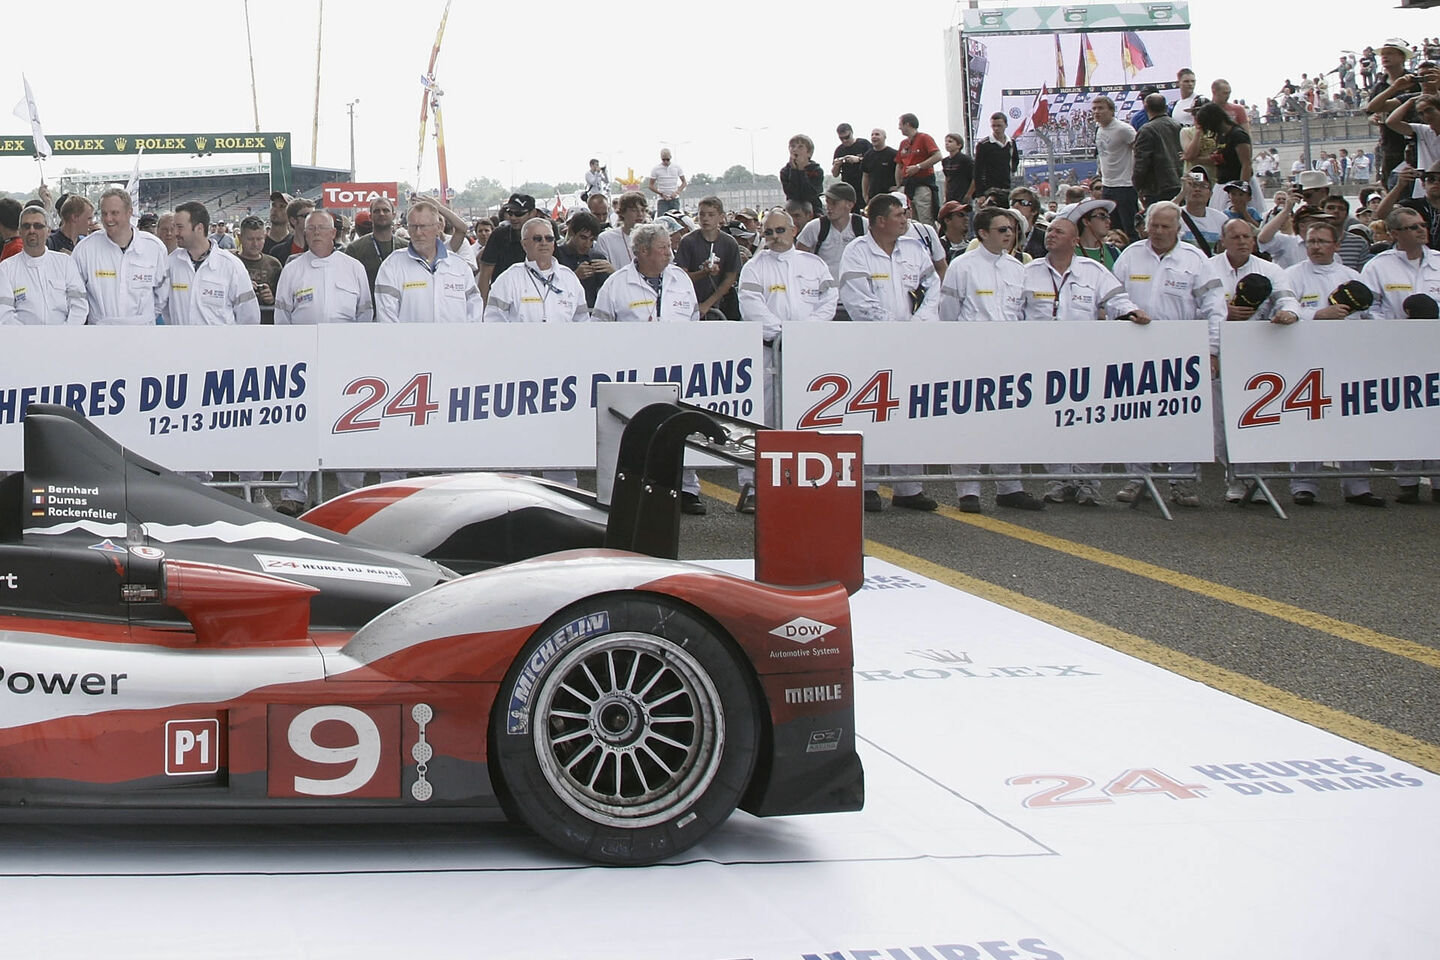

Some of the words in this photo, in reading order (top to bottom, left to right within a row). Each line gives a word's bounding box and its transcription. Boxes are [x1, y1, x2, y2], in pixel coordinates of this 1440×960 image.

[53, 139, 105, 152] ROLEX
[135, 138, 186, 150] ROLEX
[215, 137, 266, 150] ROLEX
[324, 186, 396, 204] TOTAL
[139, 371, 192, 413] DU
[204, 361, 307, 406] MANS
[796, 368, 901, 431] 24
[908, 370, 1033, 419] HEURES
[1044, 365, 1091, 405] DU
[1102, 354, 1201, 400] MANS
[1237, 367, 1333, 429] 24
[331, 372, 440, 435] 24
[447, 375, 578, 423] HEURES
[1053, 406, 1107, 428] 12-13
[1110, 400, 1154, 422] JUIN
[1157, 394, 1202, 417] 2010
[148, 412, 205, 435] 12-13
[209, 407, 254, 430] JUIN
[258, 402, 308, 425] 2010
[761, 450, 857, 489] TDI
[48, 485, 99, 496] Bernhard
[48, 495, 88, 506] Dumas
[48, 507, 118, 520] Rockenfeller
[268, 559, 299, 569] 24
[303, 564, 344, 572] HEURES
[785, 625, 822, 637] DOW
[515, 613, 606, 703] MICHELIN
[770, 649, 810, 658] Automotive
[812, 647, 840, 656] Systems
[855, 663, 1104, 683] ROLEX
[784, 684, 842, 704] MAHLE
[174, 728, 210, 765] P1
[287, 704, 382, 797] 9
[1005, 767, 1214, 809] 24
[1190, 755, 1388, 782] HEURES
[1224, 779, 1295, 796] DU
[1296, 771, 1425, 792] MANS
